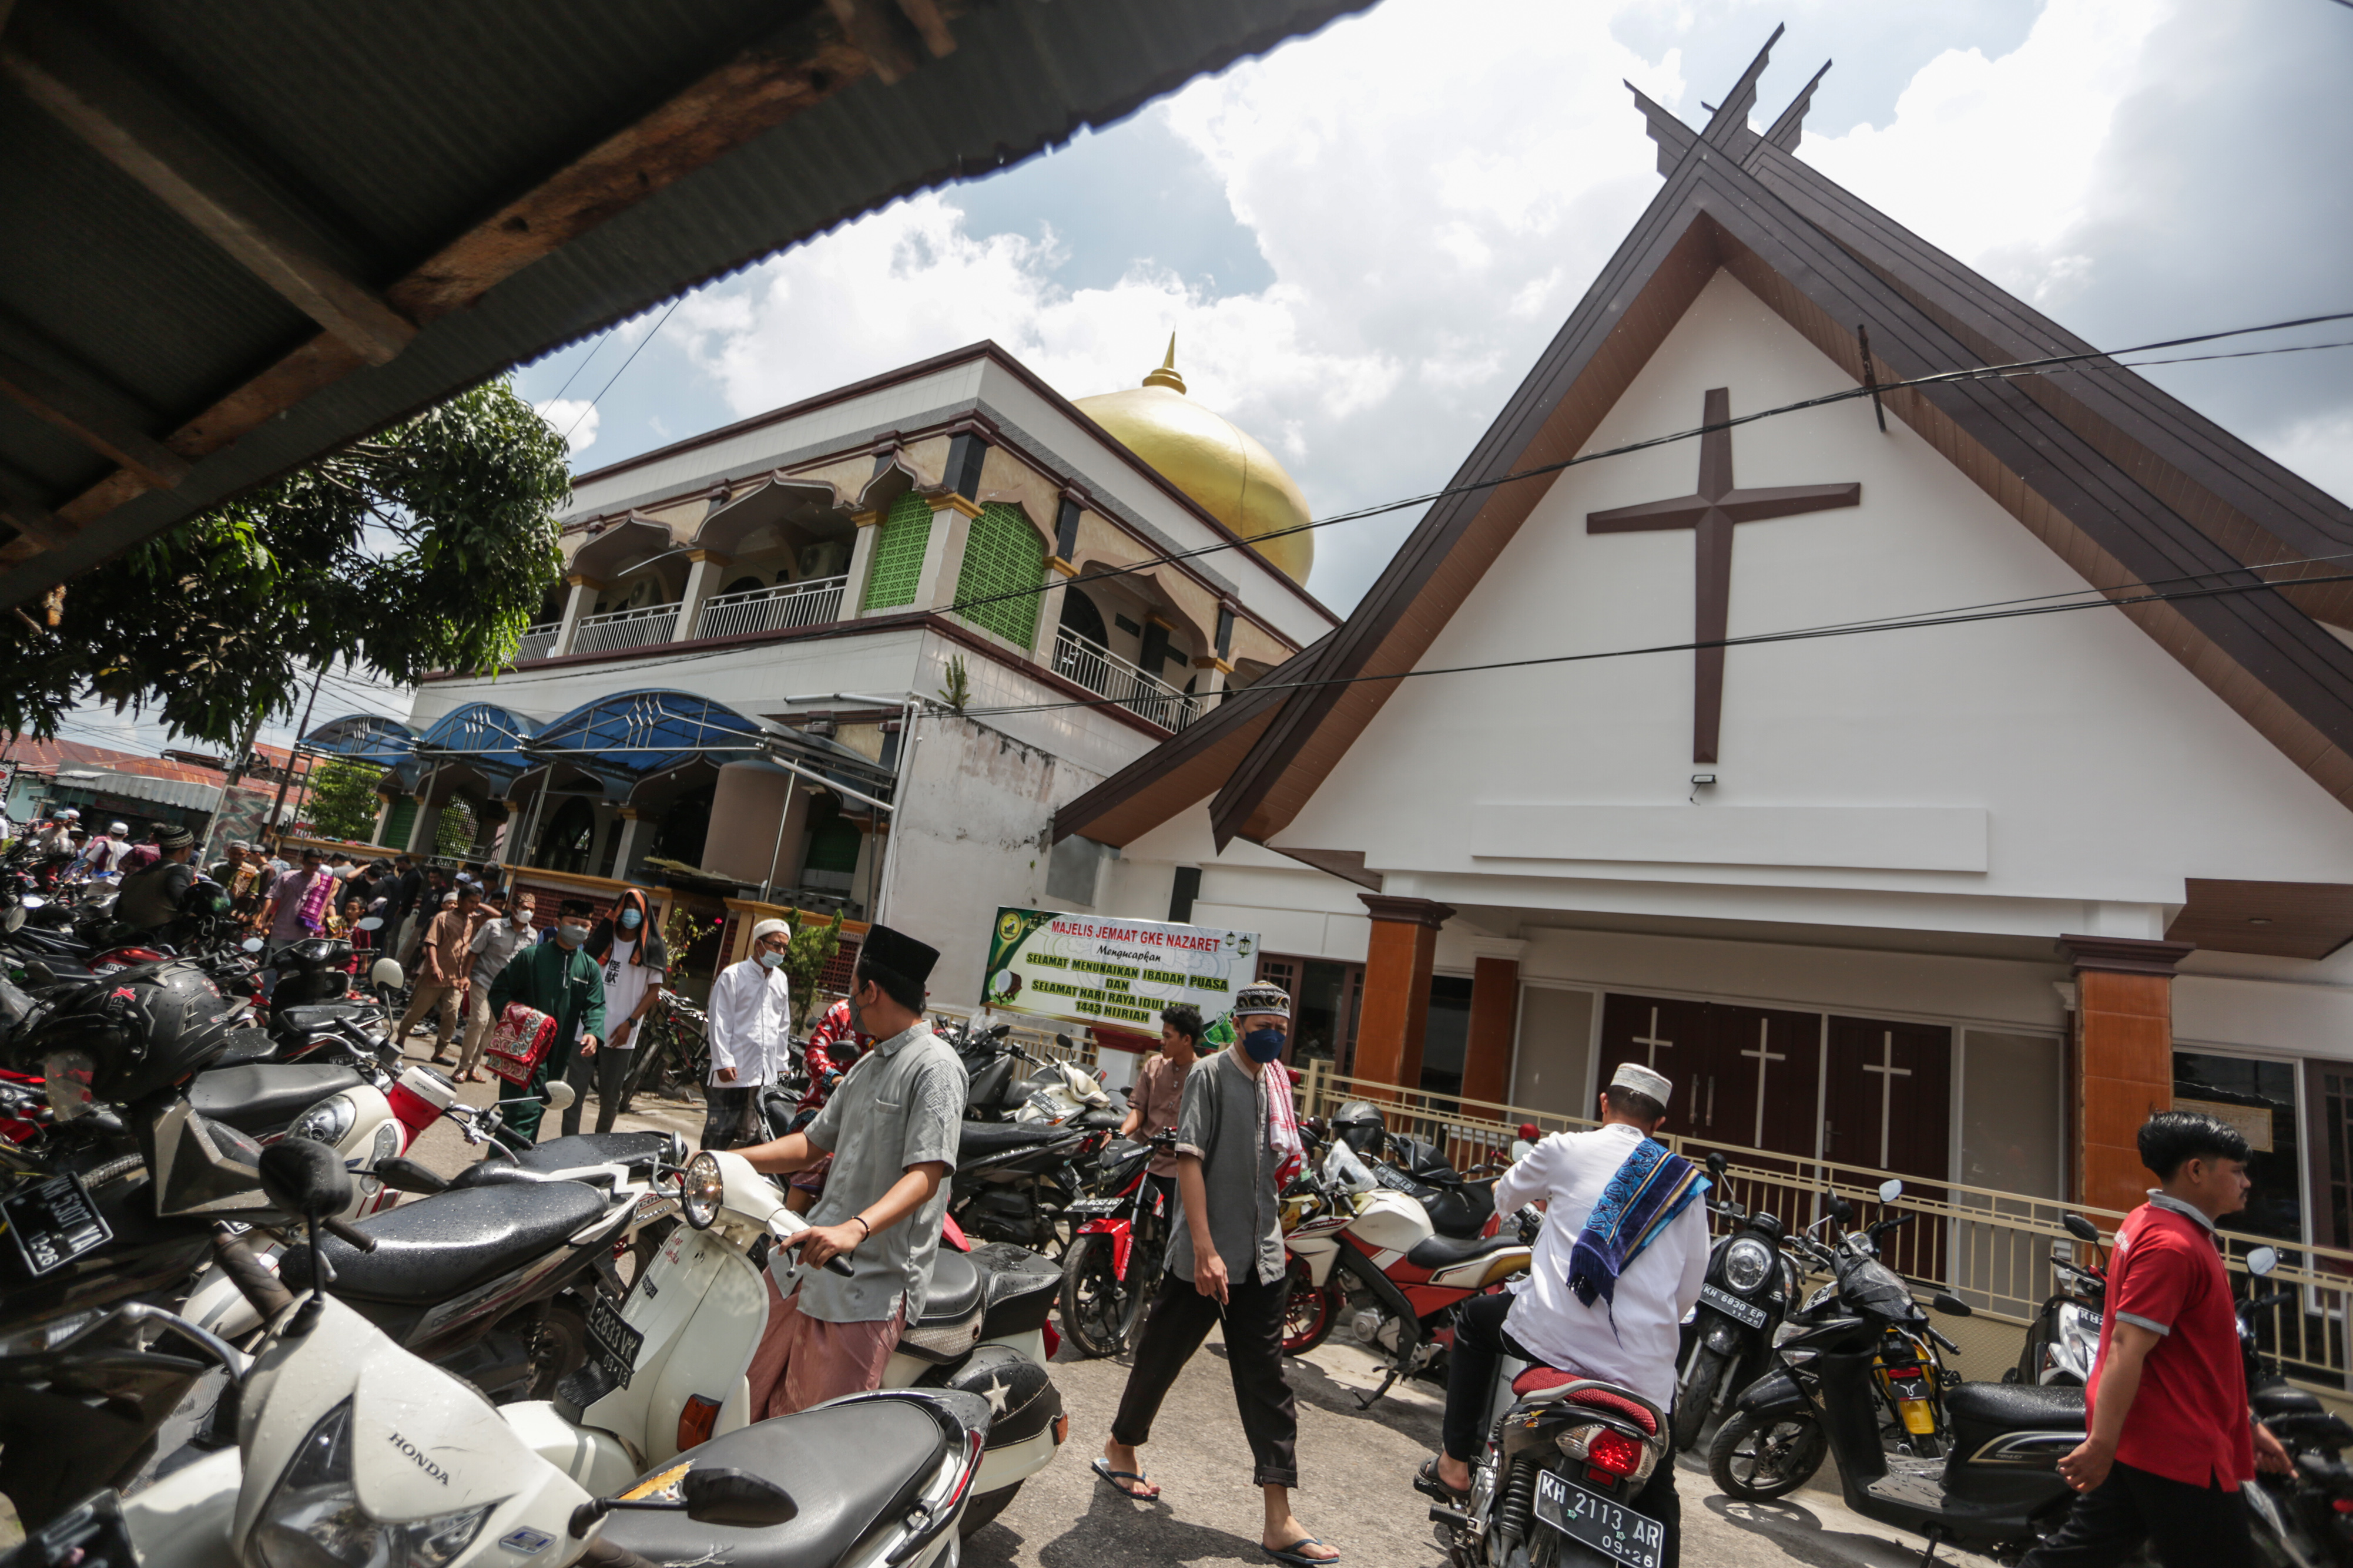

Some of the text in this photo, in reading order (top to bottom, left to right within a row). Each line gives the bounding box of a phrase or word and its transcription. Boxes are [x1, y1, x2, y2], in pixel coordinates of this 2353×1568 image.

[1051, 921, 1221, 953] MAJELIS JEMAAT GKE NAZARET
[1097, 945, 1161, 963] Mengucapkan
[1027, 953, 1229, 992] SELAMAT MENUNAIKAN IBADAH PUASA
[1105, 978, 1130, 992] DAN
[1032, 979, 1080, 997] SELAMAT
[1080, 988, 1107, 1002] HARI
[1108, 993, 1137, 1007] RAYA
[1139, 996, 1166, 1011] IDUL
[1075, 1000, 1150, 1023] 1443 HIJRIAH
[41, 1176, 73, 1200] KH
[68, 1225, 103, 1253] YA
[1703, 1285, 1764, 1319] KH 6830 EP
[2080, 1310, 2099, 1324] KH
[596, 1308, 621, 1349] 2833
[1794, 1366, 1819, 1379] HONDA
[1614, 1425, 1638, 1438] HONDA
[388, 1431, 450, 1486] HONDA
[1541, 1475, 1659, 1549] KH 2113 AR
